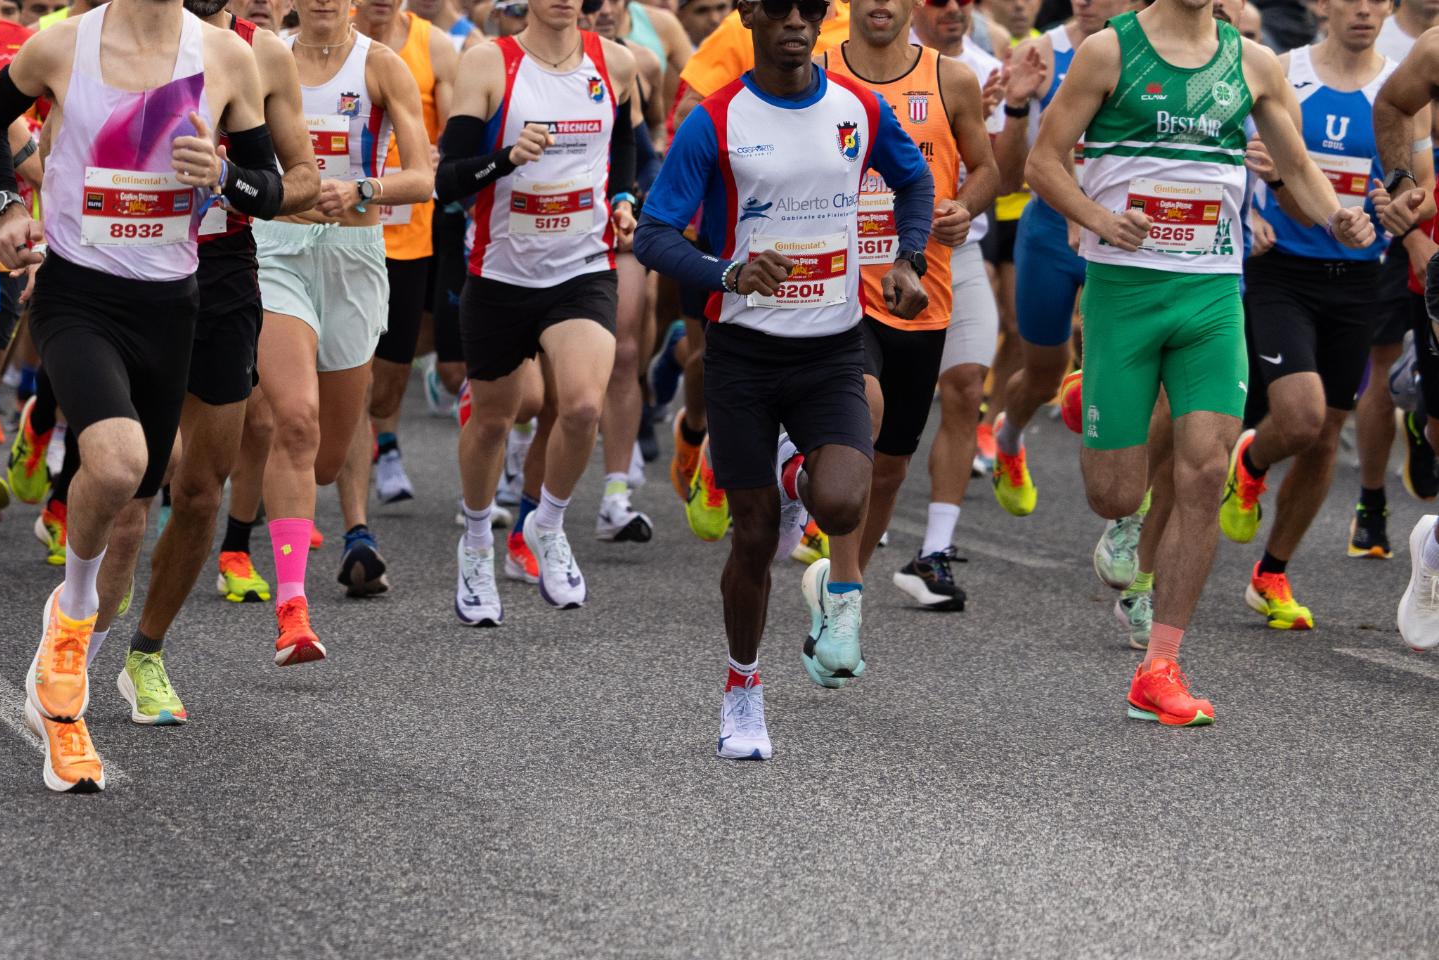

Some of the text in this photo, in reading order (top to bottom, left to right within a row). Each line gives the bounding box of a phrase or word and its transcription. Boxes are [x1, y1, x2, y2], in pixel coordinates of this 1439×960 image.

[1325, 114, 1350, 141] U
[111, 173, 161, 186] Continental
[775, 196, 829, 212] Alberto
[535, 216, 570, 229] 5179
[110, 223, 164, 238] 8932
[1149, 226, 1195, 241] 6265
[774, 241, 820, 252] Continental
[773, 283, 825, 298] 6204
